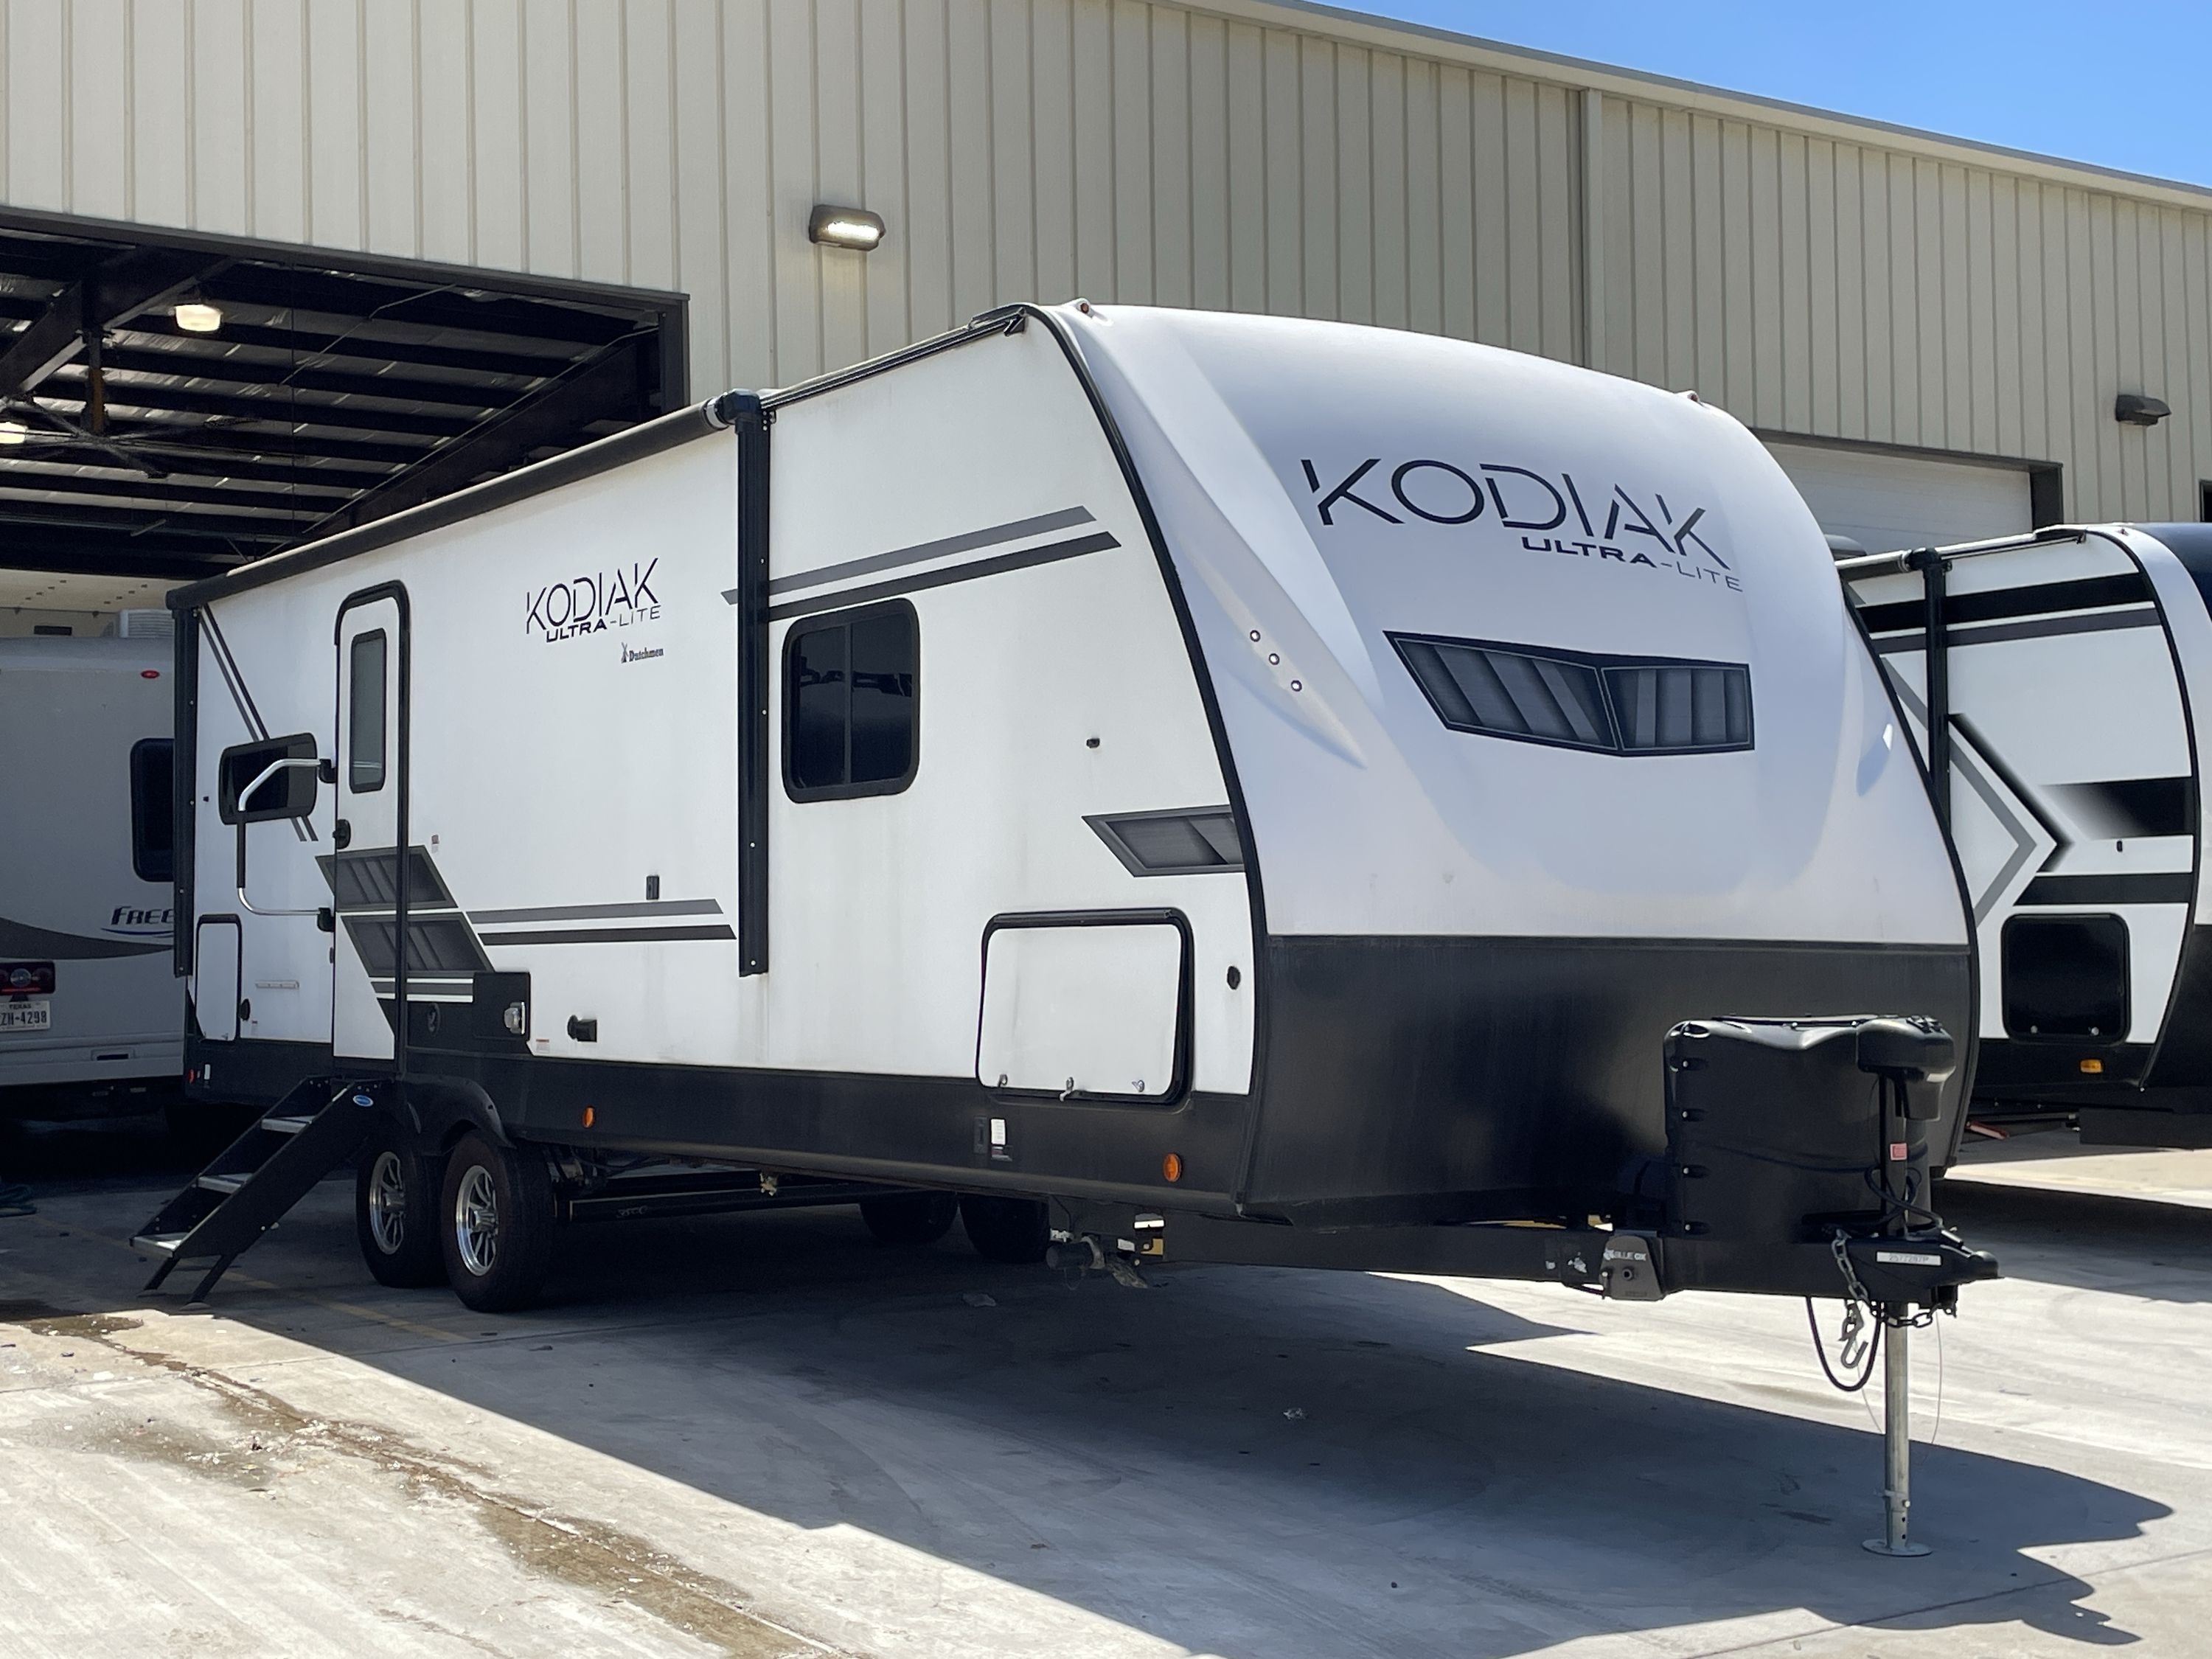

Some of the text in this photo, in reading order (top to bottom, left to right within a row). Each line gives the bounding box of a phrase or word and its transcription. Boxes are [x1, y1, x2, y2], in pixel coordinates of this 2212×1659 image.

[1301, 458, 1731, 571] KODIAK
[1521, 537, 1743, 593] ULTRA-LITE
[526, 557, 658, 634] KODIAK
[546, 605, 661, 642] ULTRA-LITE
[629, 647, 664, 662] Dutchmen
